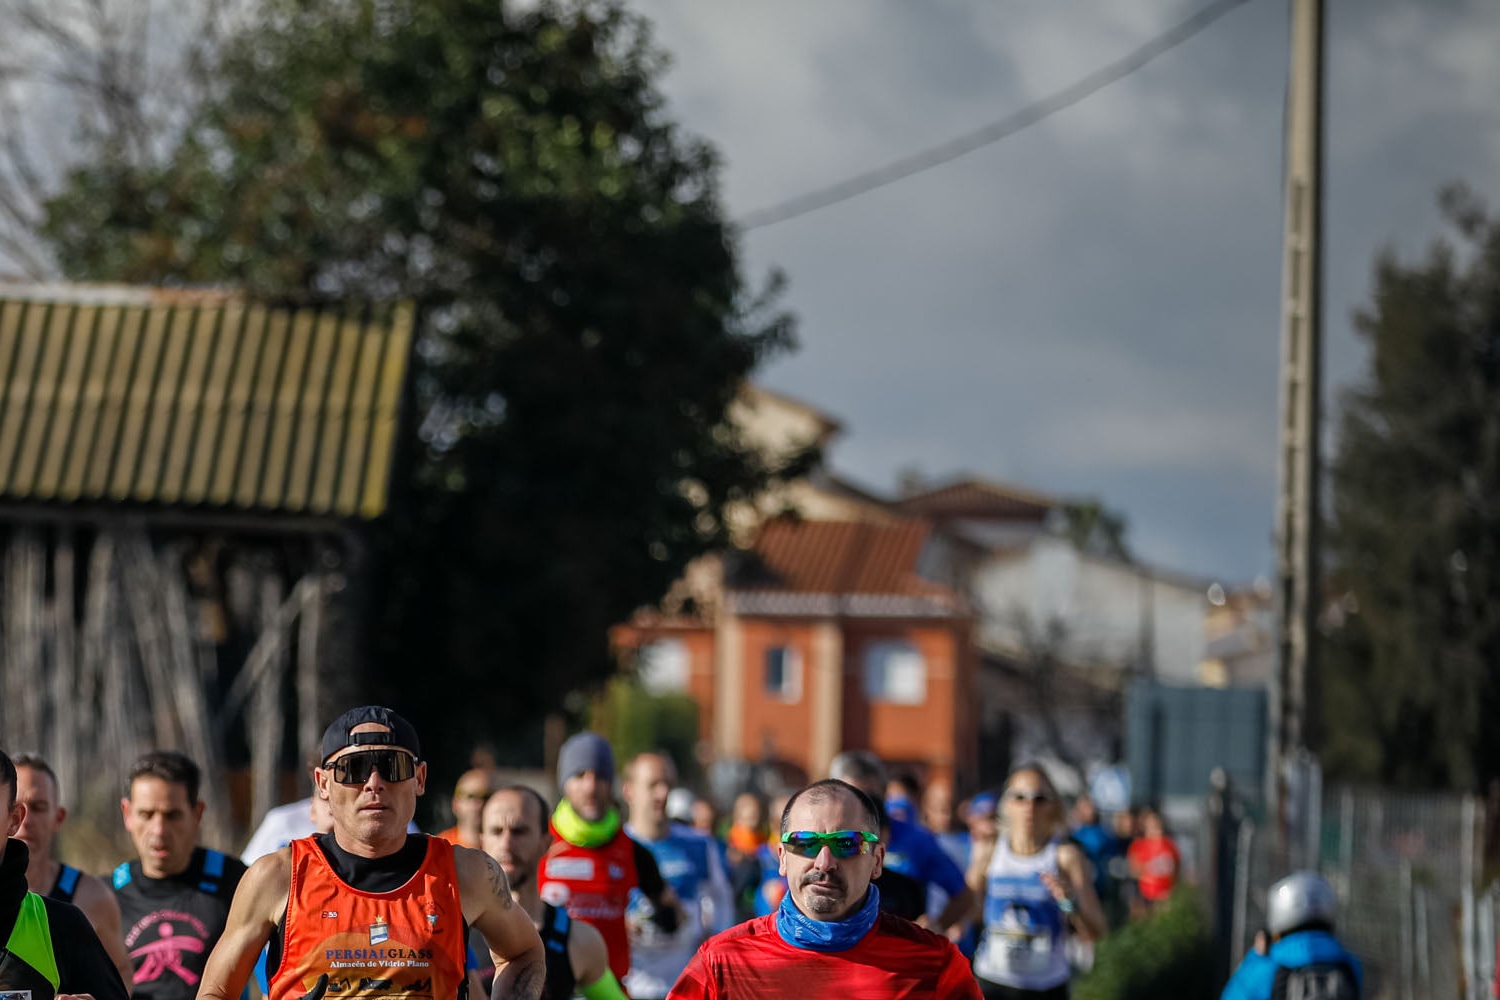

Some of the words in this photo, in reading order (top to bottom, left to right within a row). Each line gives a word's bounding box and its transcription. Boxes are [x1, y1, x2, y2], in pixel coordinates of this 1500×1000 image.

[326, 948, 434, 960] PERSIALGLASS
[367, 960, 377, 968] de
[379, 960, 405, 968] Vidrio
[407, 960, 429, 968] Plano
